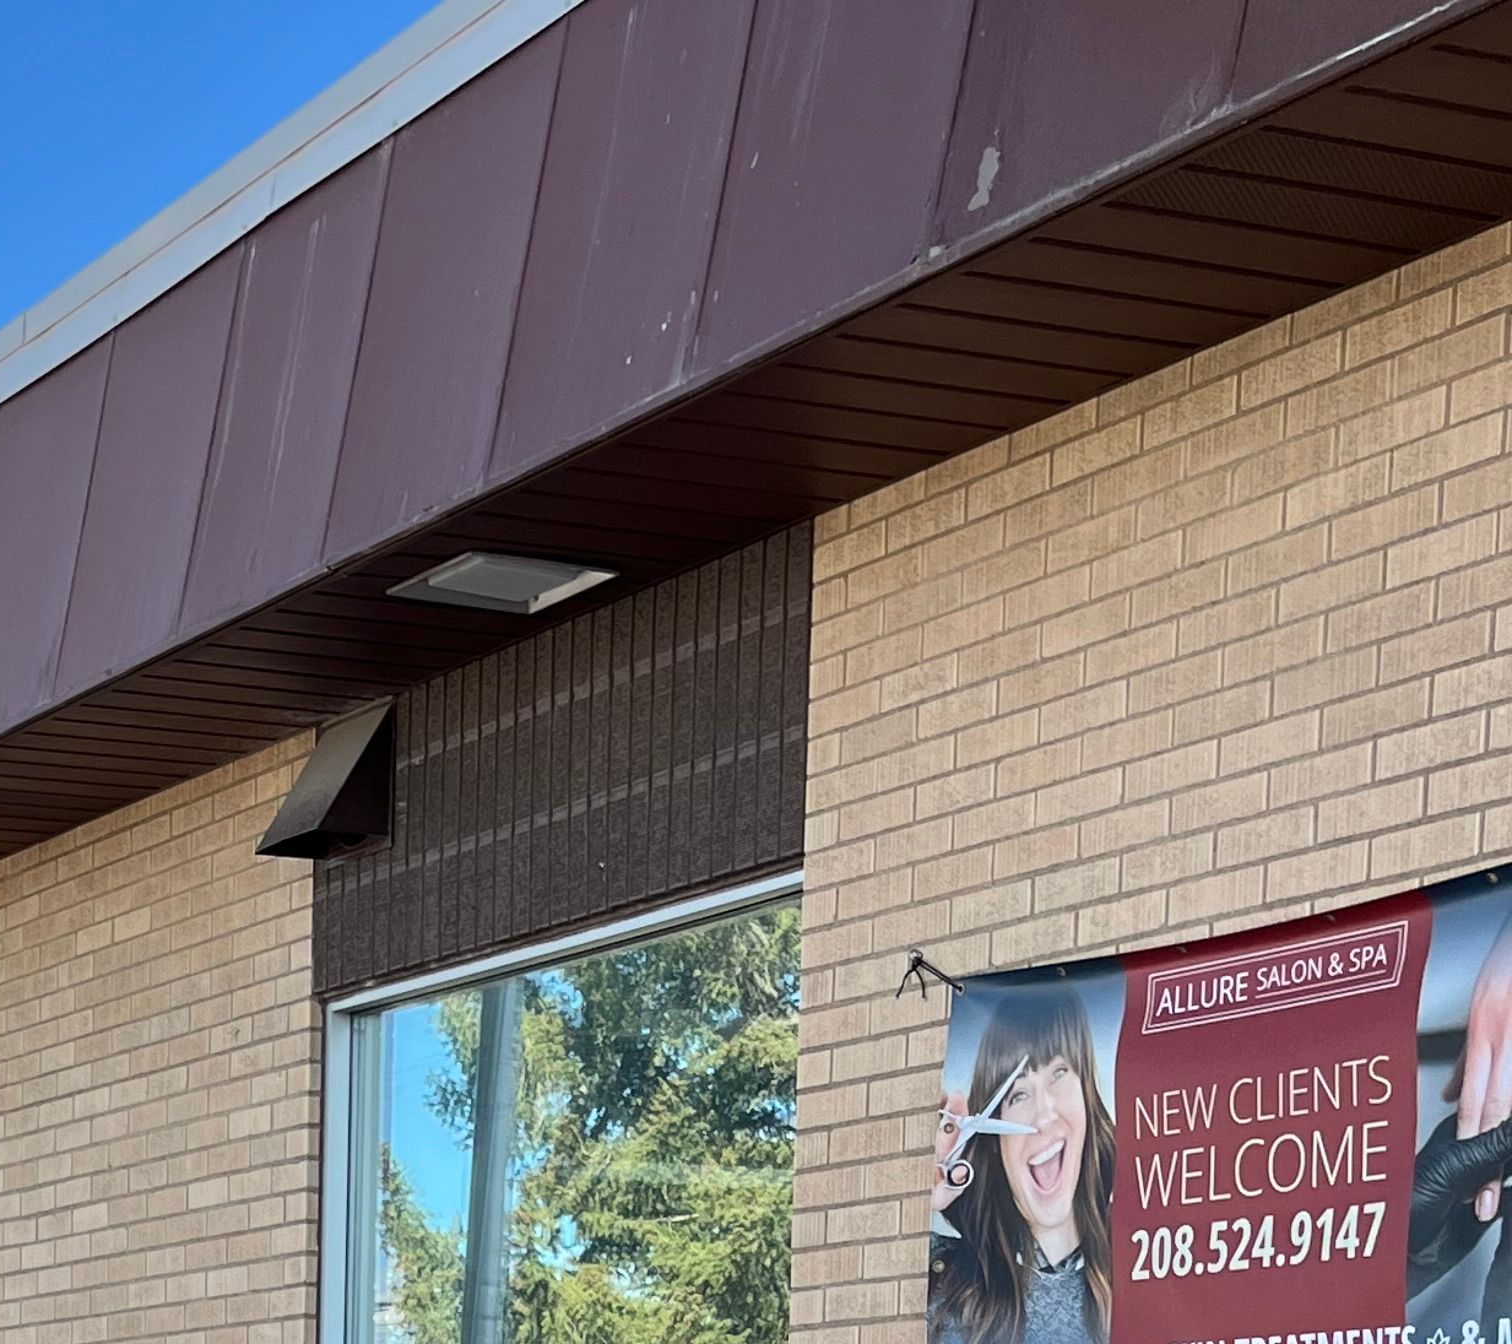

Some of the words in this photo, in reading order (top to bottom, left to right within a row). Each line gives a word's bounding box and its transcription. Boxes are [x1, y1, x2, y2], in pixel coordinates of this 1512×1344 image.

[1155, 971, 1249, 1017] ALLURE
[1256, 955, 1323, 992] SALON
[1327, 952, 1344, 977] &
[1347, 943, 1388, 973] SPA
[1134, 1083, 1218, 1140] NEW
[1228, 1055, 1393, 1124] CLIENTS
[1135, 1120, 1389, 1210] WELCOME
[1131, 1201, 1387, 1281] 208.524.9147
